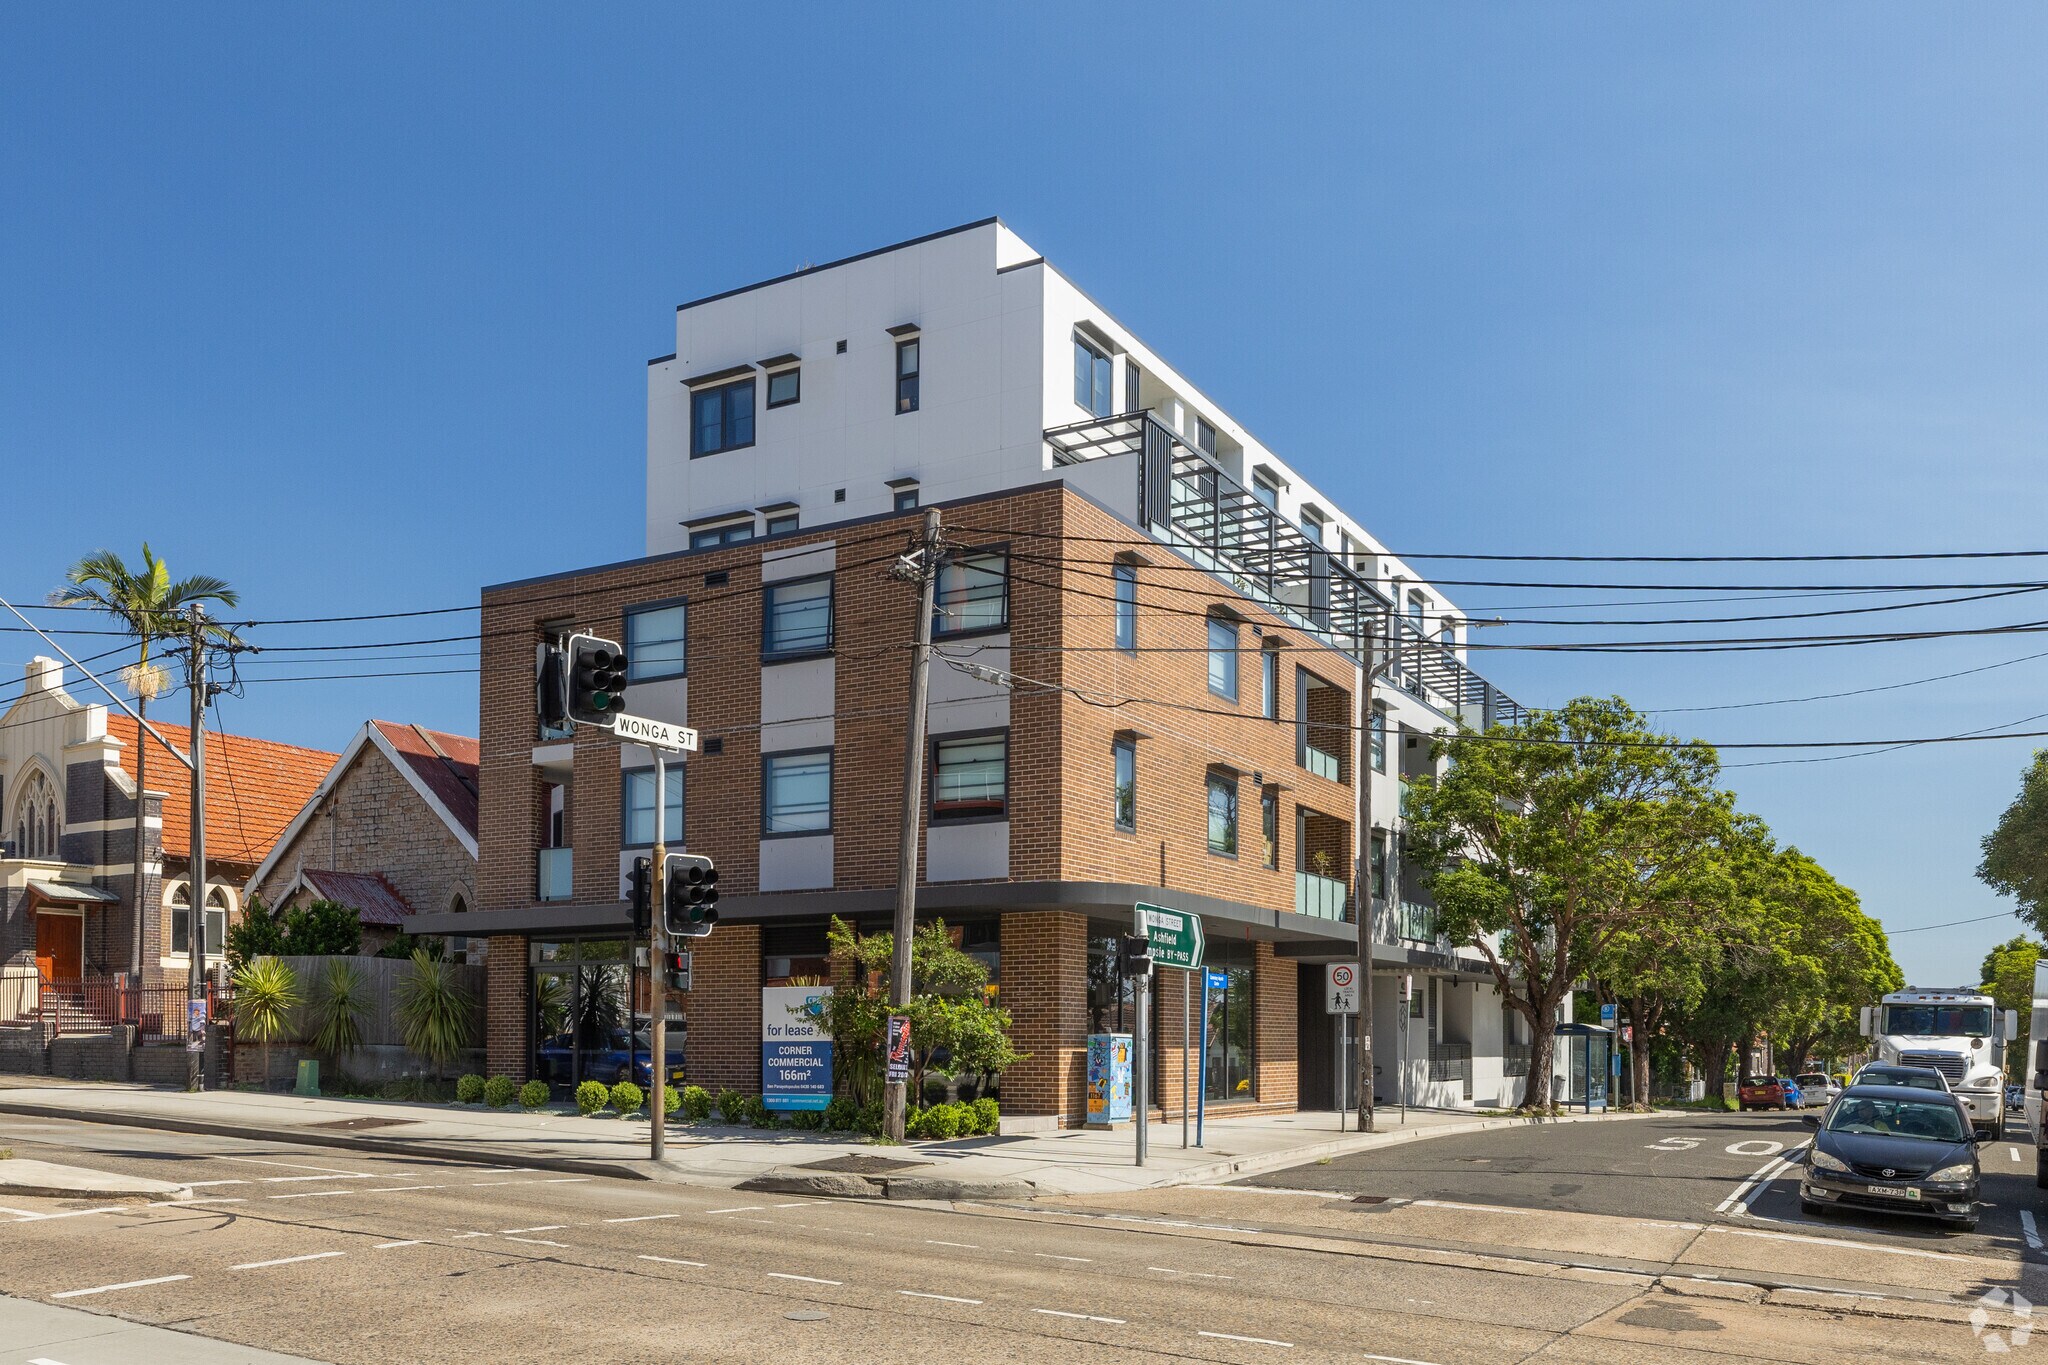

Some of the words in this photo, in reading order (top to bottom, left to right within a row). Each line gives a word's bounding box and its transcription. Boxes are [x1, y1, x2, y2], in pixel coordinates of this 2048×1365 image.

[620, 718, 669, 741] WONGA
[678, 731, 693, 745] ST
[1166, 917, 1182, 929] STREET
[1153, 931, 1177, 945] Ashfield
[1147, 947, 1165, 958] mpsie
[1167, 949, 1189, 962] BY-PASS
[1337, 972, 1349, 981] 50
[767, 1024, 782, 1036] for
[785, 1024, 813, 1036] lease
[778, 1046, 812, 1055] CORNER
[768, 1058, 823, 1067] COMMERCIAL
[779, 1070, 811, 1081] 166m²
